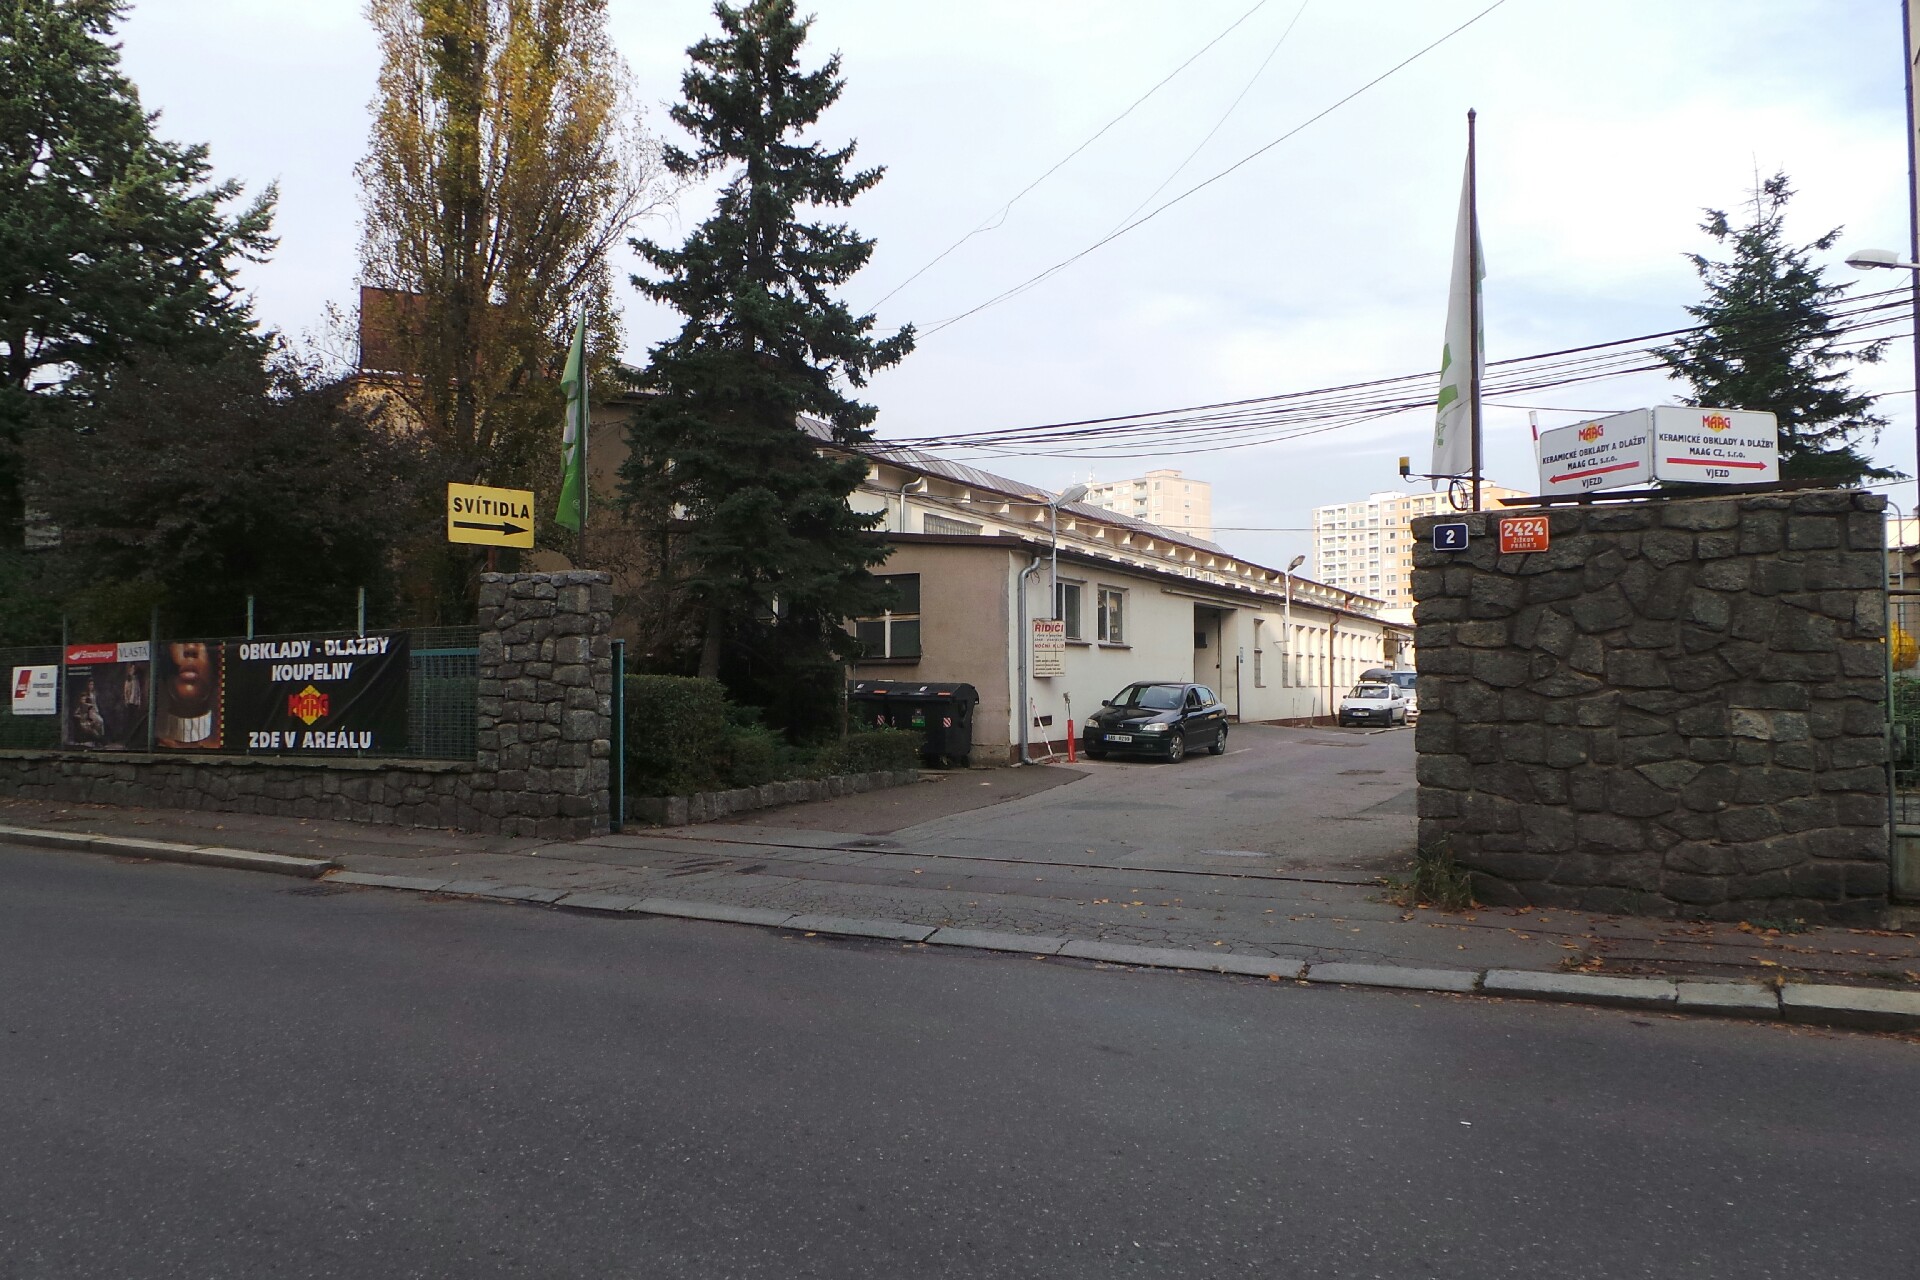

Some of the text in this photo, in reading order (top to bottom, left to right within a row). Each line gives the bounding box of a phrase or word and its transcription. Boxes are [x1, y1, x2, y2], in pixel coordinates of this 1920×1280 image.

[1702, 414, 1731, 430] MAAG
[1578, 424, 1604, 442] MAAG
[1579, 443, 1611, 458] OBKLADY
[1611, 442, 1617, 450] A
[1619, 435, 1647, 449] DLAŽBY
[1703, 436, 1738, 446] OBKLADY
[1739, 438, 1745, 446] A
[1747, 437, 1774, 449] DLAŽBY
[1689, 447, 1746, 459] MAAG CZ, s.r.o.
[1567, 460, 1586, 471] MAAG
[1600, 456, 1618, 465] s.r.o.
[1706, 468, 1730, 479] VJEZD
[1582, 477, 1603, 488] VJEZD
[453, 496, 530, 519] SVÍTIDLA
[1446, 529, 1455, 544] 2
[1504, 521, 1544, 537] 2424
[1034, 622, 1064, 632] ŘIDIČI
[120, 645, 148, 658] VLASTA
[239, 640, 311, 661] OBKLADY
[324, 634, 390, 656] DLAŽBY
[271, 662, 353, 682] KOUPELNY
[249, 726, 372, 749] ZDE V AREÁLU
